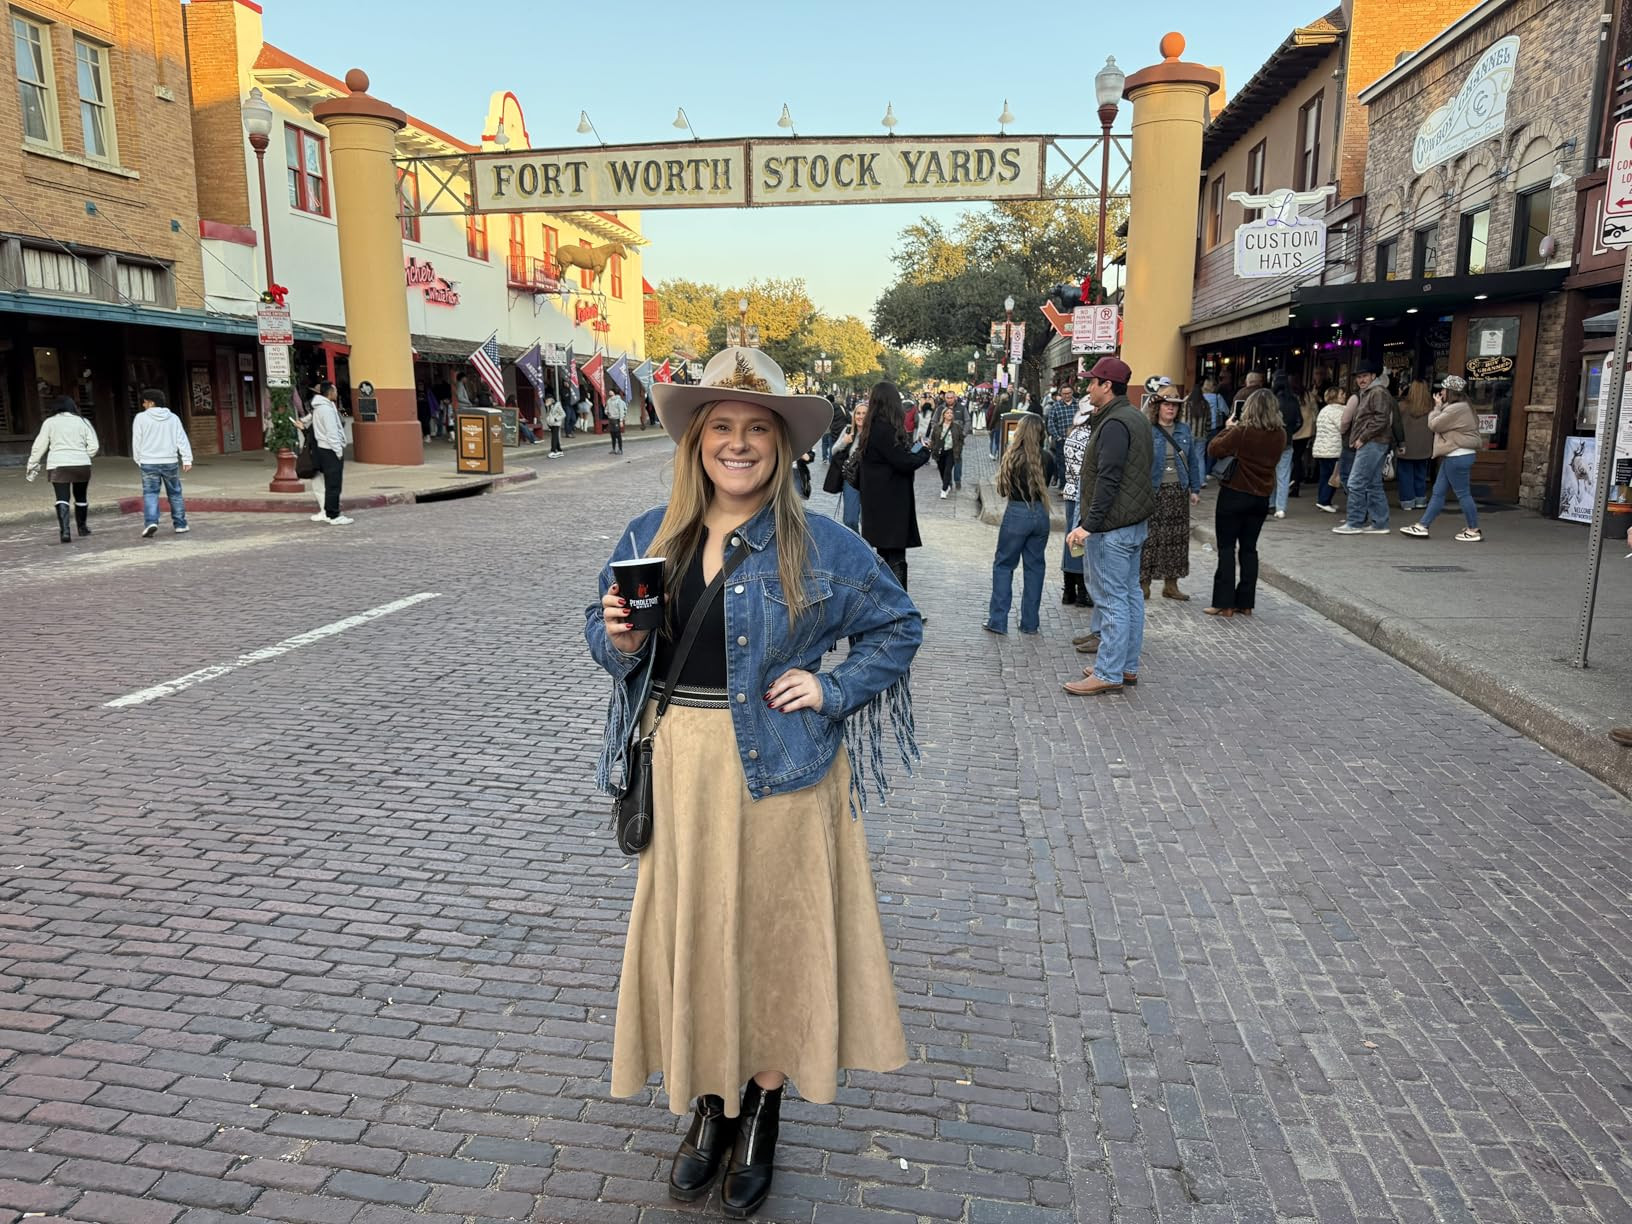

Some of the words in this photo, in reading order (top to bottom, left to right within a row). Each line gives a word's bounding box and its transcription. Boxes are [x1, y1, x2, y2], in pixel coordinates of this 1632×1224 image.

[1416, 116, 1453, 164] COWBOY
[1458, 46, 1511, 112] CHANNEL
[492, 161, 588, 198] FORT
[607, 158, 732, 195] WORTH
[763, 152, 881, 190] STOCK
[900, 147, 1020, 184] YARDS
[1245, 230, 1318, 250] CUSTOM
[1260, 251, 1302, 269] HATS
